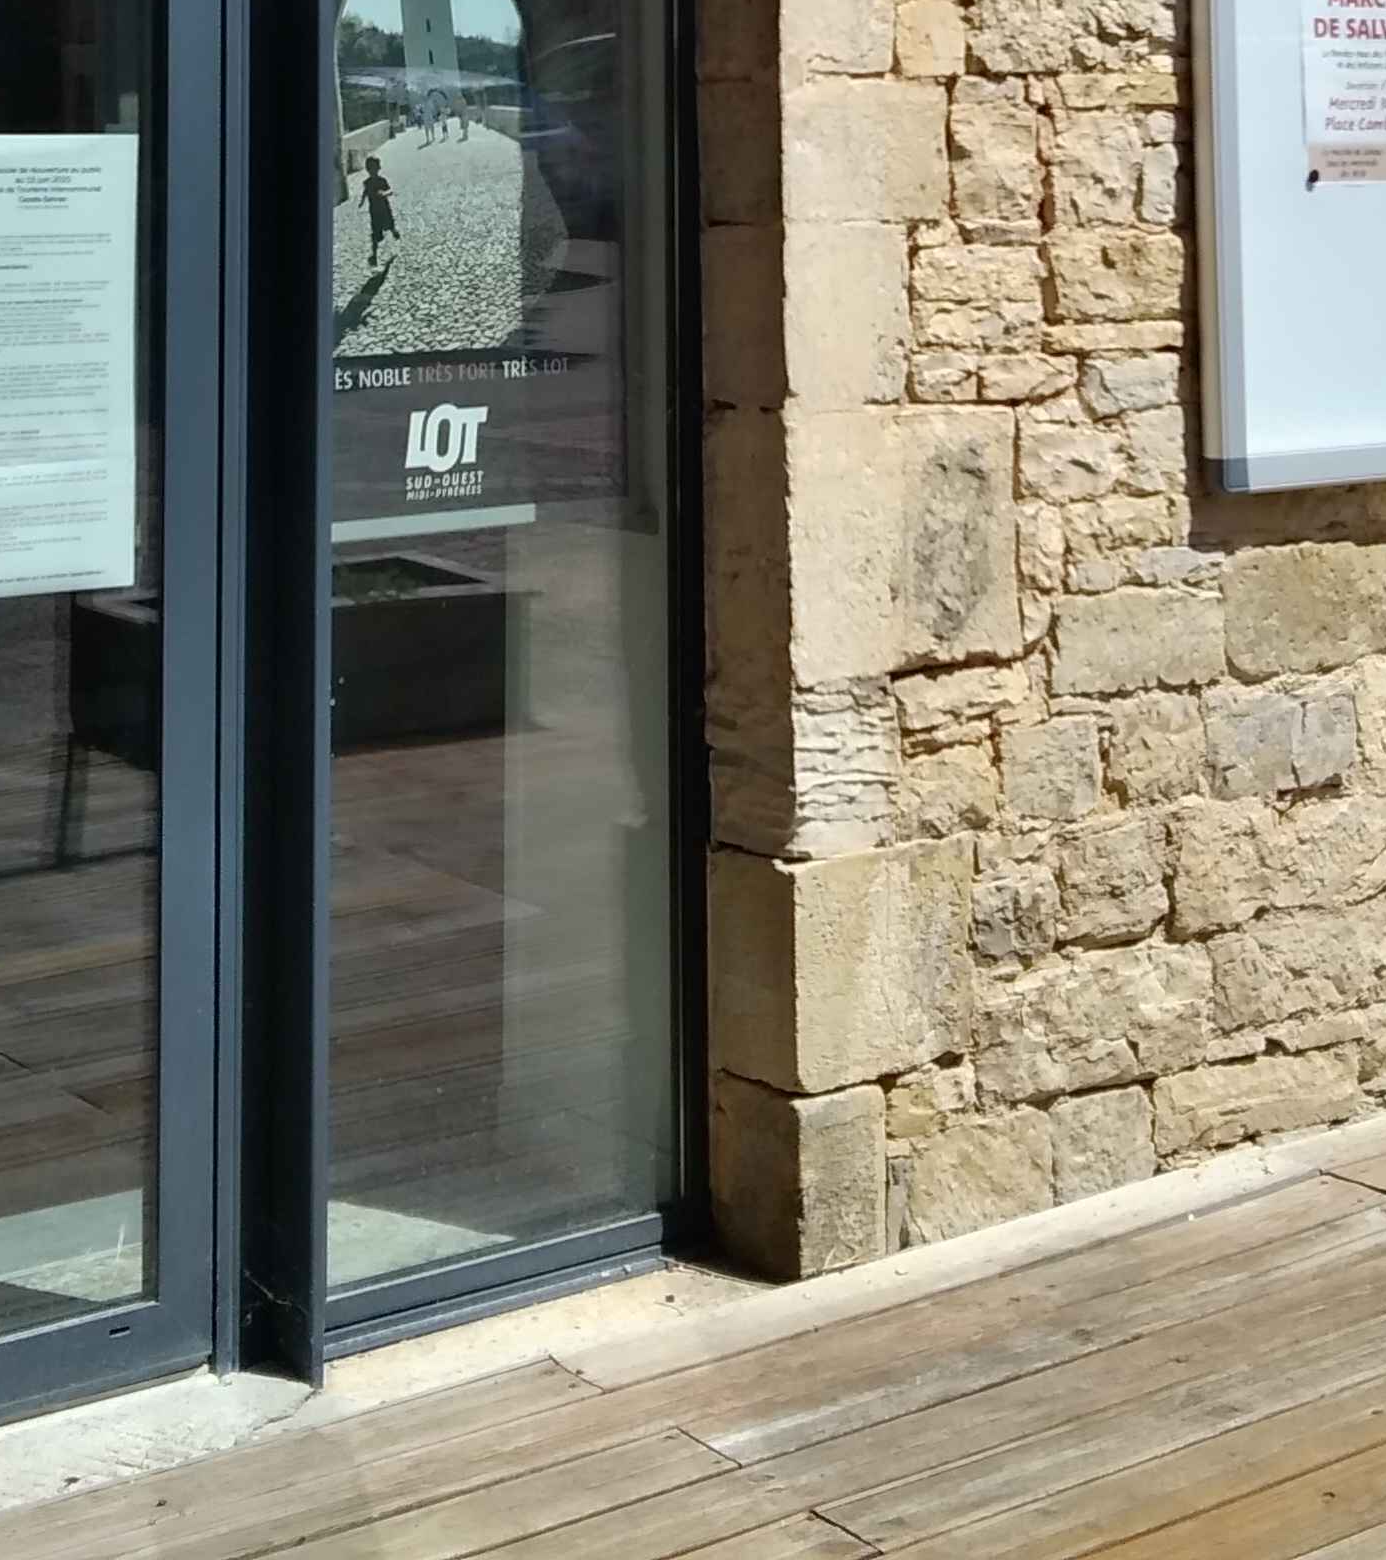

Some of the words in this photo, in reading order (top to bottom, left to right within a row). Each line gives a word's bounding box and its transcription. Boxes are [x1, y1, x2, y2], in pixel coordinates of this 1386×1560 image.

[1313, 17, 1340, 39] DE
[1328, 95, 1376, 110] Mercredi
[1325, 116, 1355, 131] Place
[358, 367, 412, 388] NOBLE
[417, 361, 454, 384] TRÈS
[460, 362, 498, 382] FORT
[501, 355, 538, 380] TRÈS
[543, 357, 570, 376] LOT
[404, 403, 490, 473] LOT
[405, 470, 485, 491] SUD-OUEST
